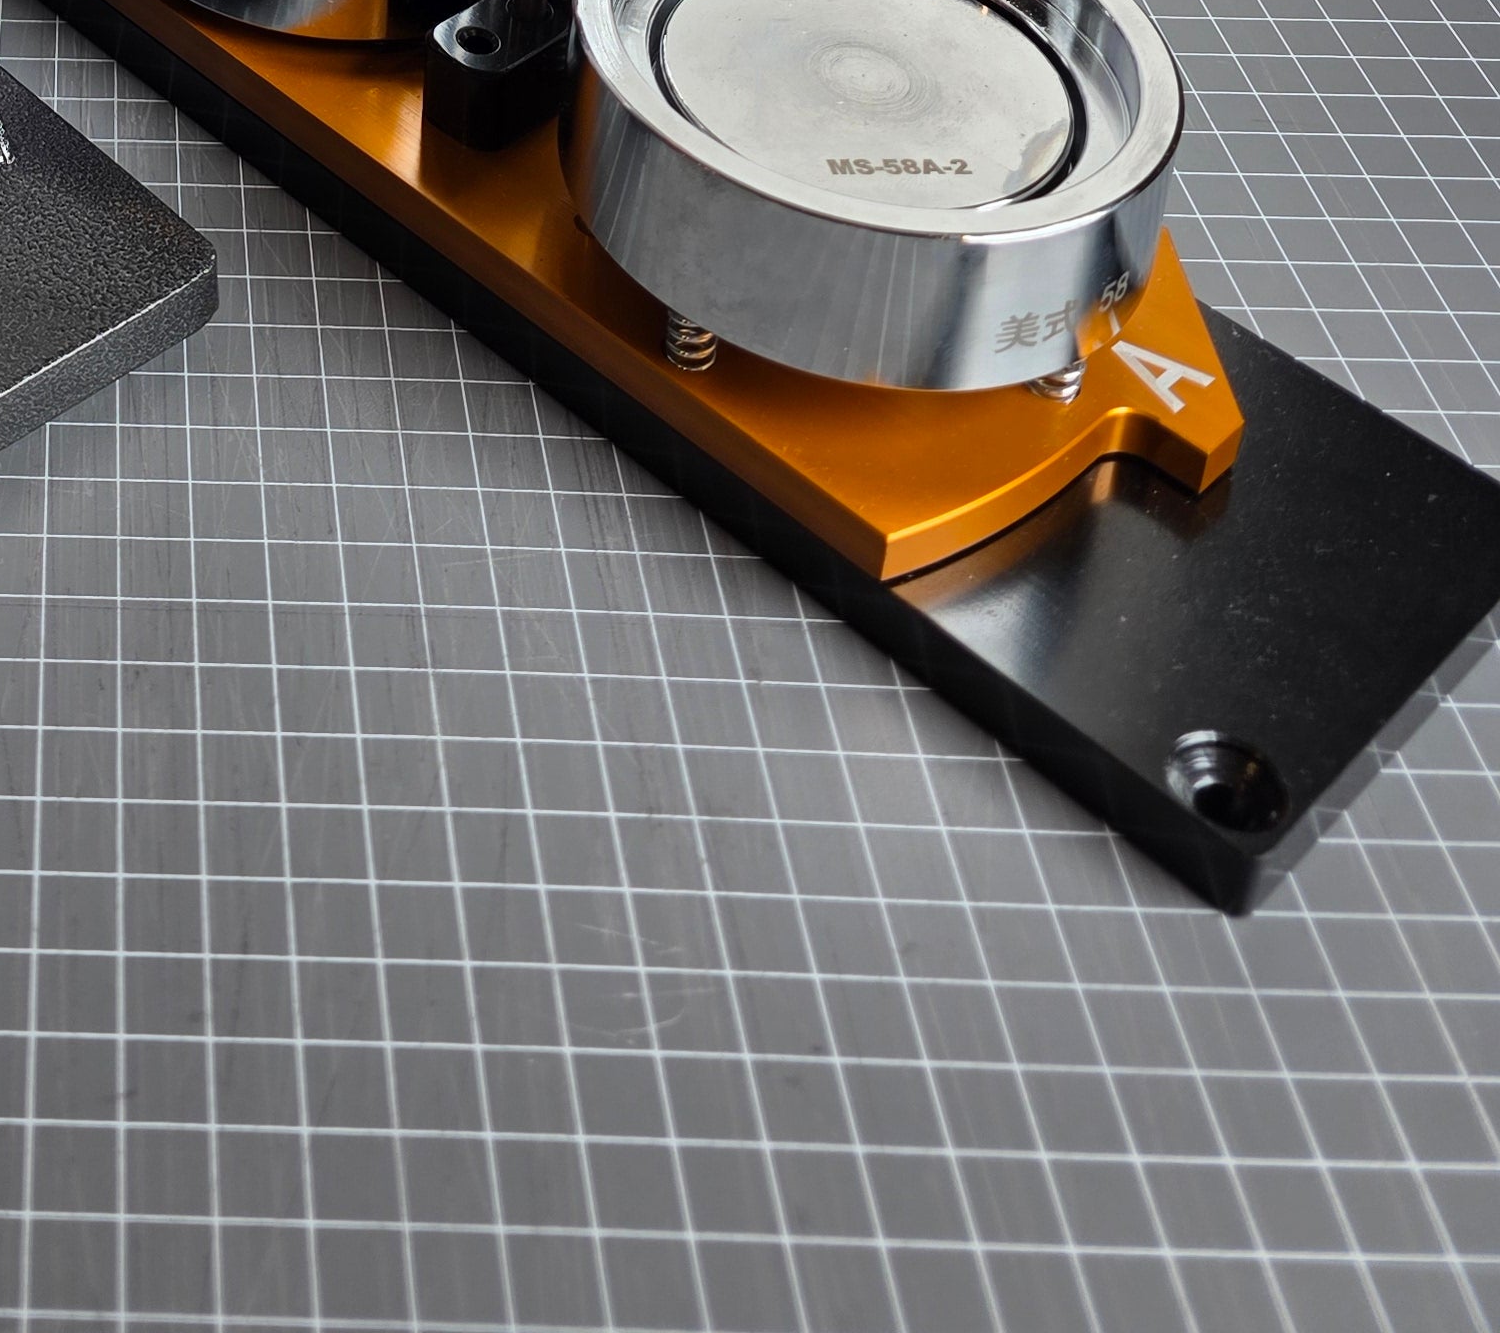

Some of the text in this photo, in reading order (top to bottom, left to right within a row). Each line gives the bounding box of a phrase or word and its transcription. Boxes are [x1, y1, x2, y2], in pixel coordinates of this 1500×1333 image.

[825, 157, 974, 176] MS-58A-2
[994, 270, 1130, 354] 美式 58
[1110, 339, 1217, 414] A
